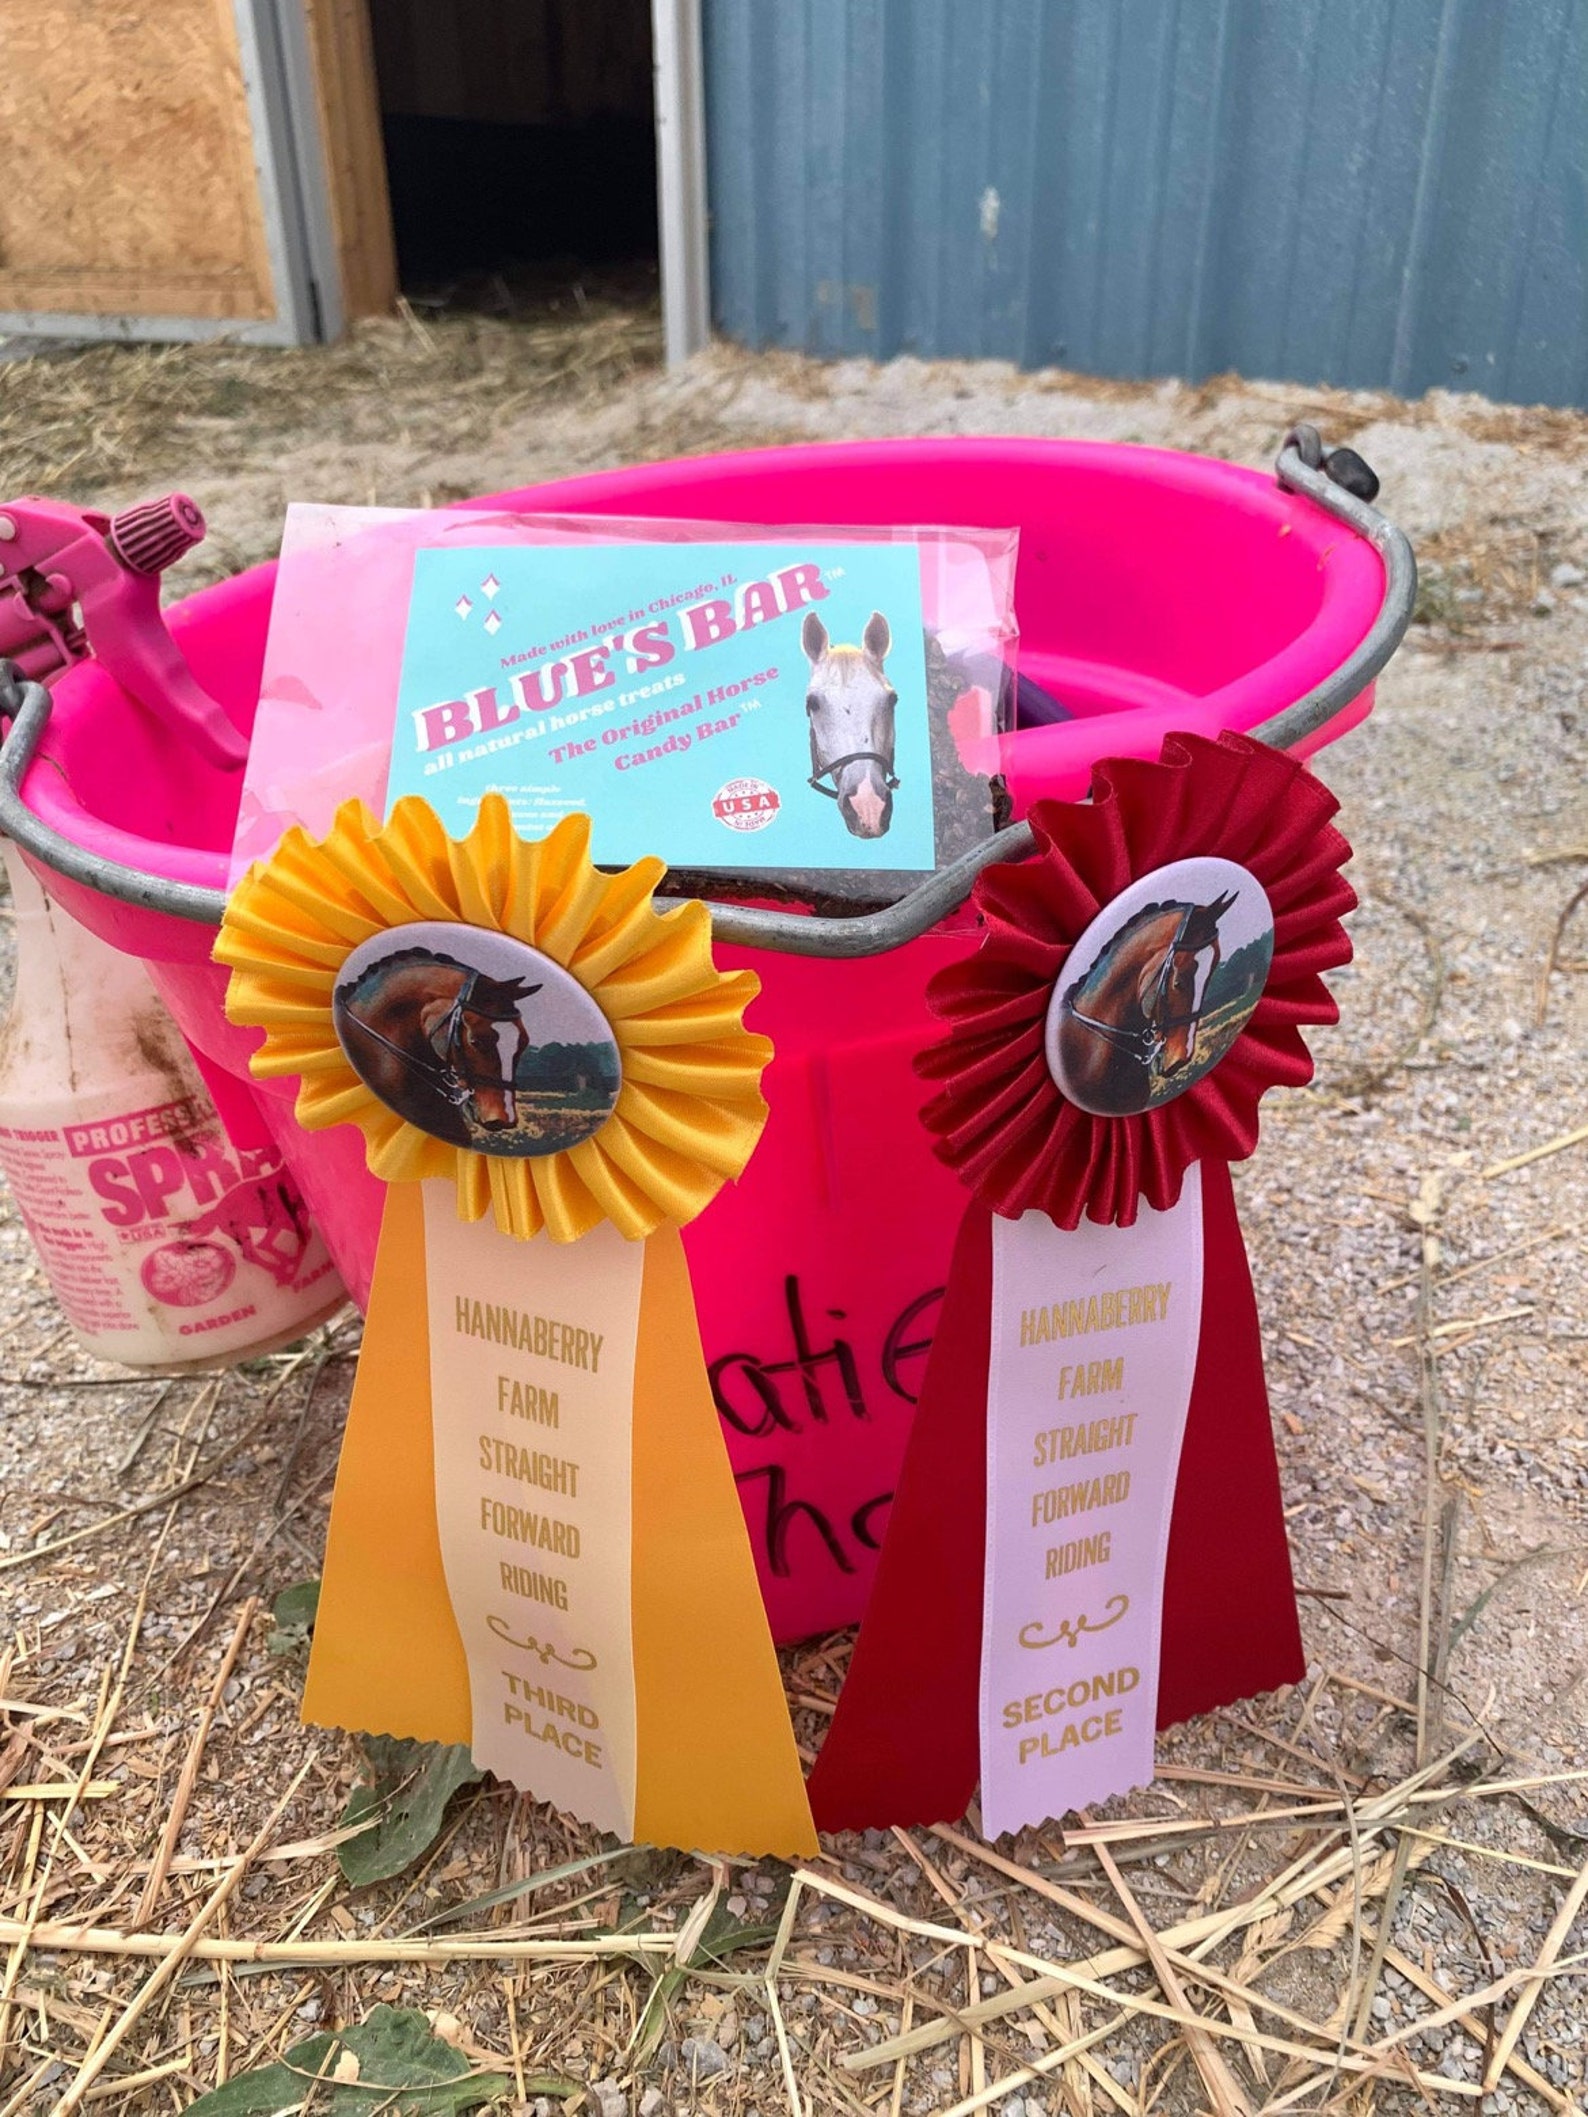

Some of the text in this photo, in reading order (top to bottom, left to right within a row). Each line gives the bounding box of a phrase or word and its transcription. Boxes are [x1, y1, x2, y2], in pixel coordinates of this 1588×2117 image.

[500, 573, 738, 669] Made with love in Chicago, IL
[411, 620, 676, 752] BLUE'S
[677, 563, 831, 652] BAR
[423, 672, 687, 777] all natural horse treats
[548, 666, 780, 765] The Original Horse
[614, 733, 692, 772] Candy
[695, 712, 742, 742] Bar
[519, 784, 561, 794] simple
[721, 796, 771, 814] USA
[178, 1304, 257, 1336] GARDEN
[455, 1295, 604, 1374] HANNABERRY
[1019, 1281, 1173, 1348] HANNABERRY
[497, 1375, 560, 1430] FARM
[1058, 1356, 1125, 1401] FARM
[479, 1435, 580, 1499] STRAIGHT
[1033, 1412, 1139, 1468] STRAIGHT
[480, 1497, 581, 1560] FORWARD
[1031, 1470, 1132, 1528] FORWARD
[1045, 1530, 1112, 1581] RIDING
[499, 1561, 569, 1613] RIDING
[501, 1671, 601, 1731] THIRD
[1002, 1666, 1141, 1730] SECOND
[503, 1701, 603, 1770] PLACE
[1018, 1708, 1124, 1765] PLACE
